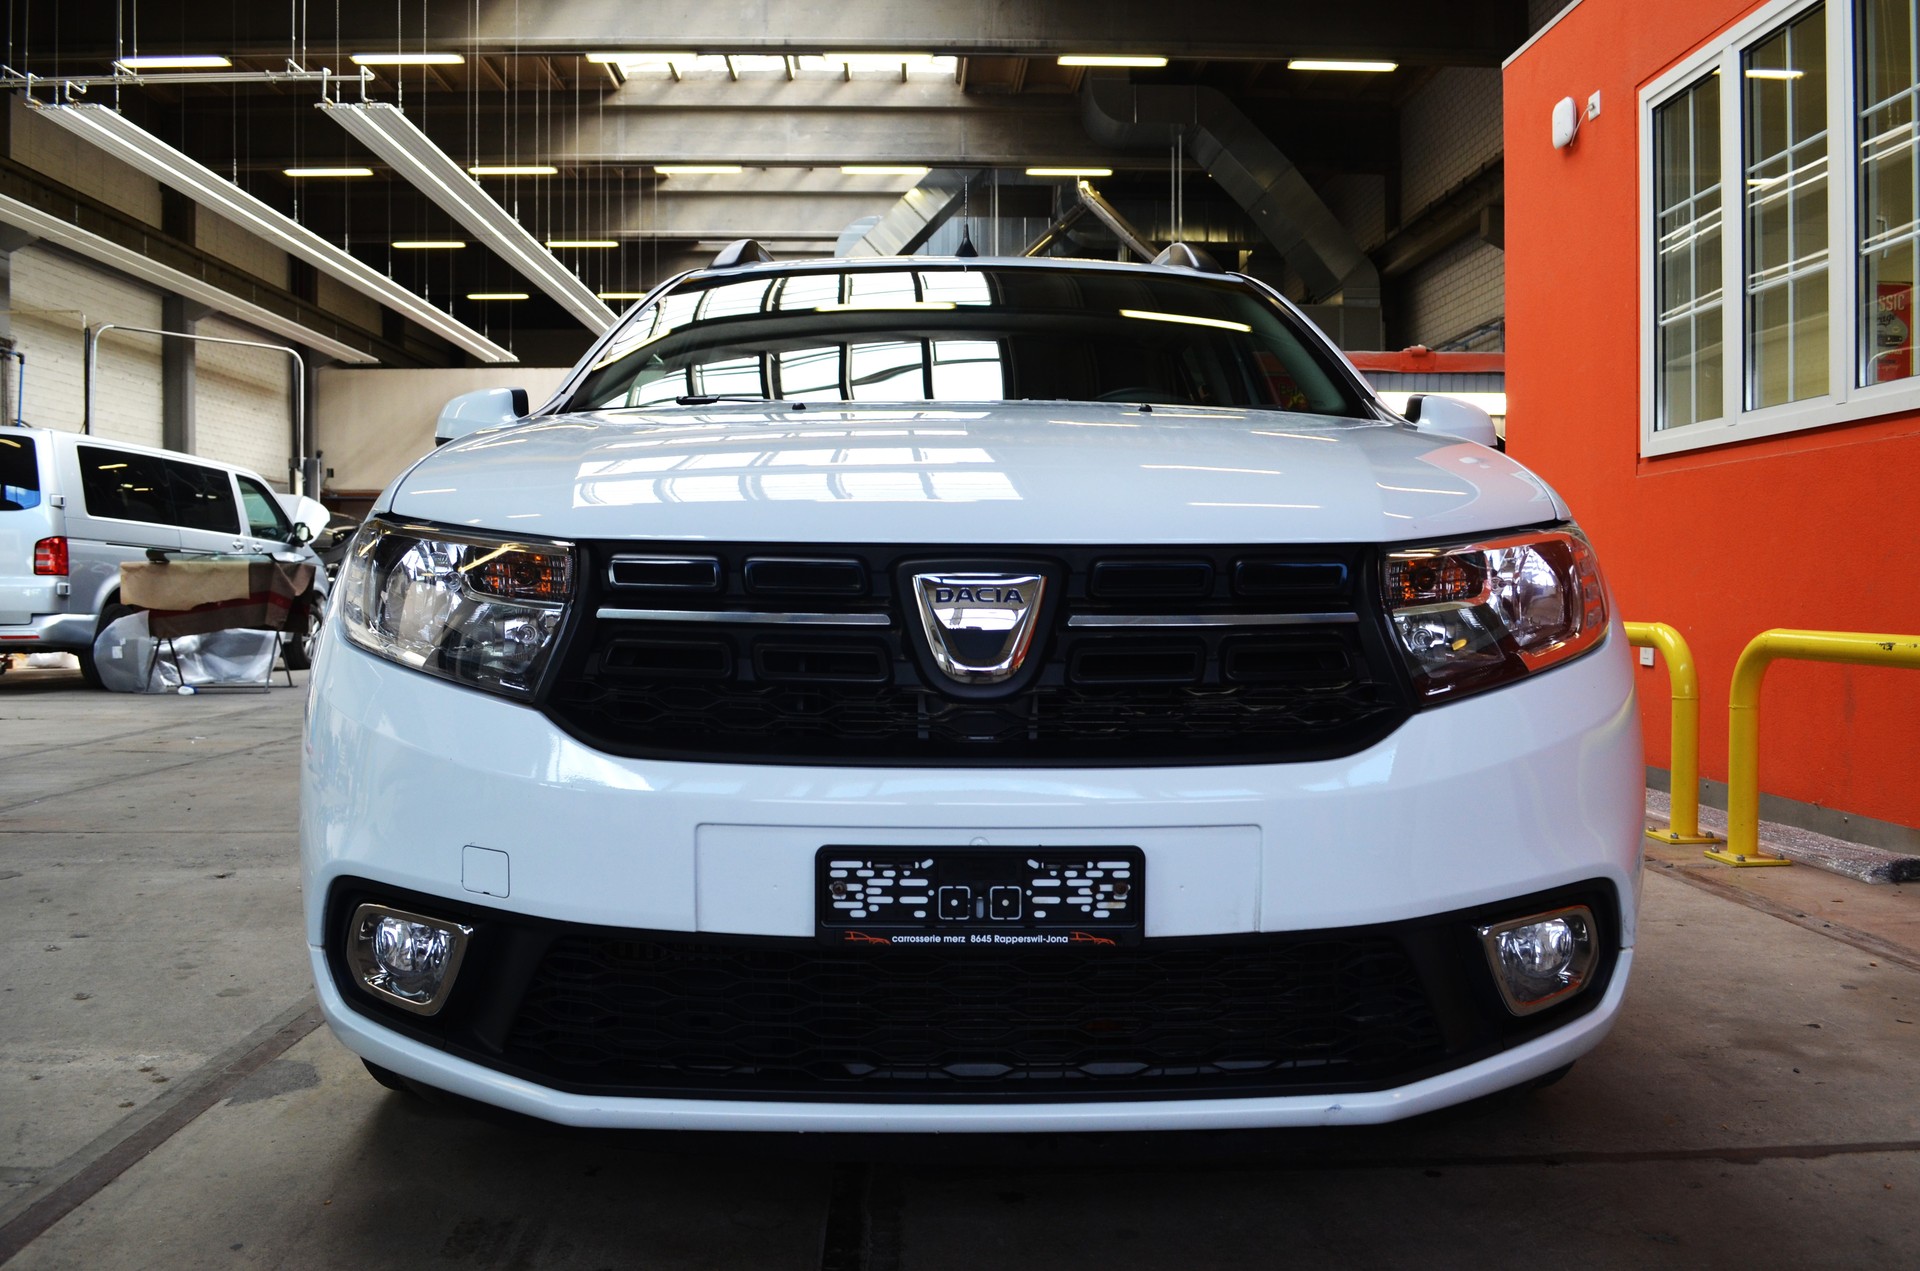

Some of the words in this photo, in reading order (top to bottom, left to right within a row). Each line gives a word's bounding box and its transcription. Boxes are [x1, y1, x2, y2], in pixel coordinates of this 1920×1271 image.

[935, 587, 1024, 604] DACIA
[892, 934, 942, 943] carrosserie
[943, 935, 965, 943] merz
[970, 934, 991, 943] 8645
[993, 934, 1069, 945] Rapperswil-Jona
